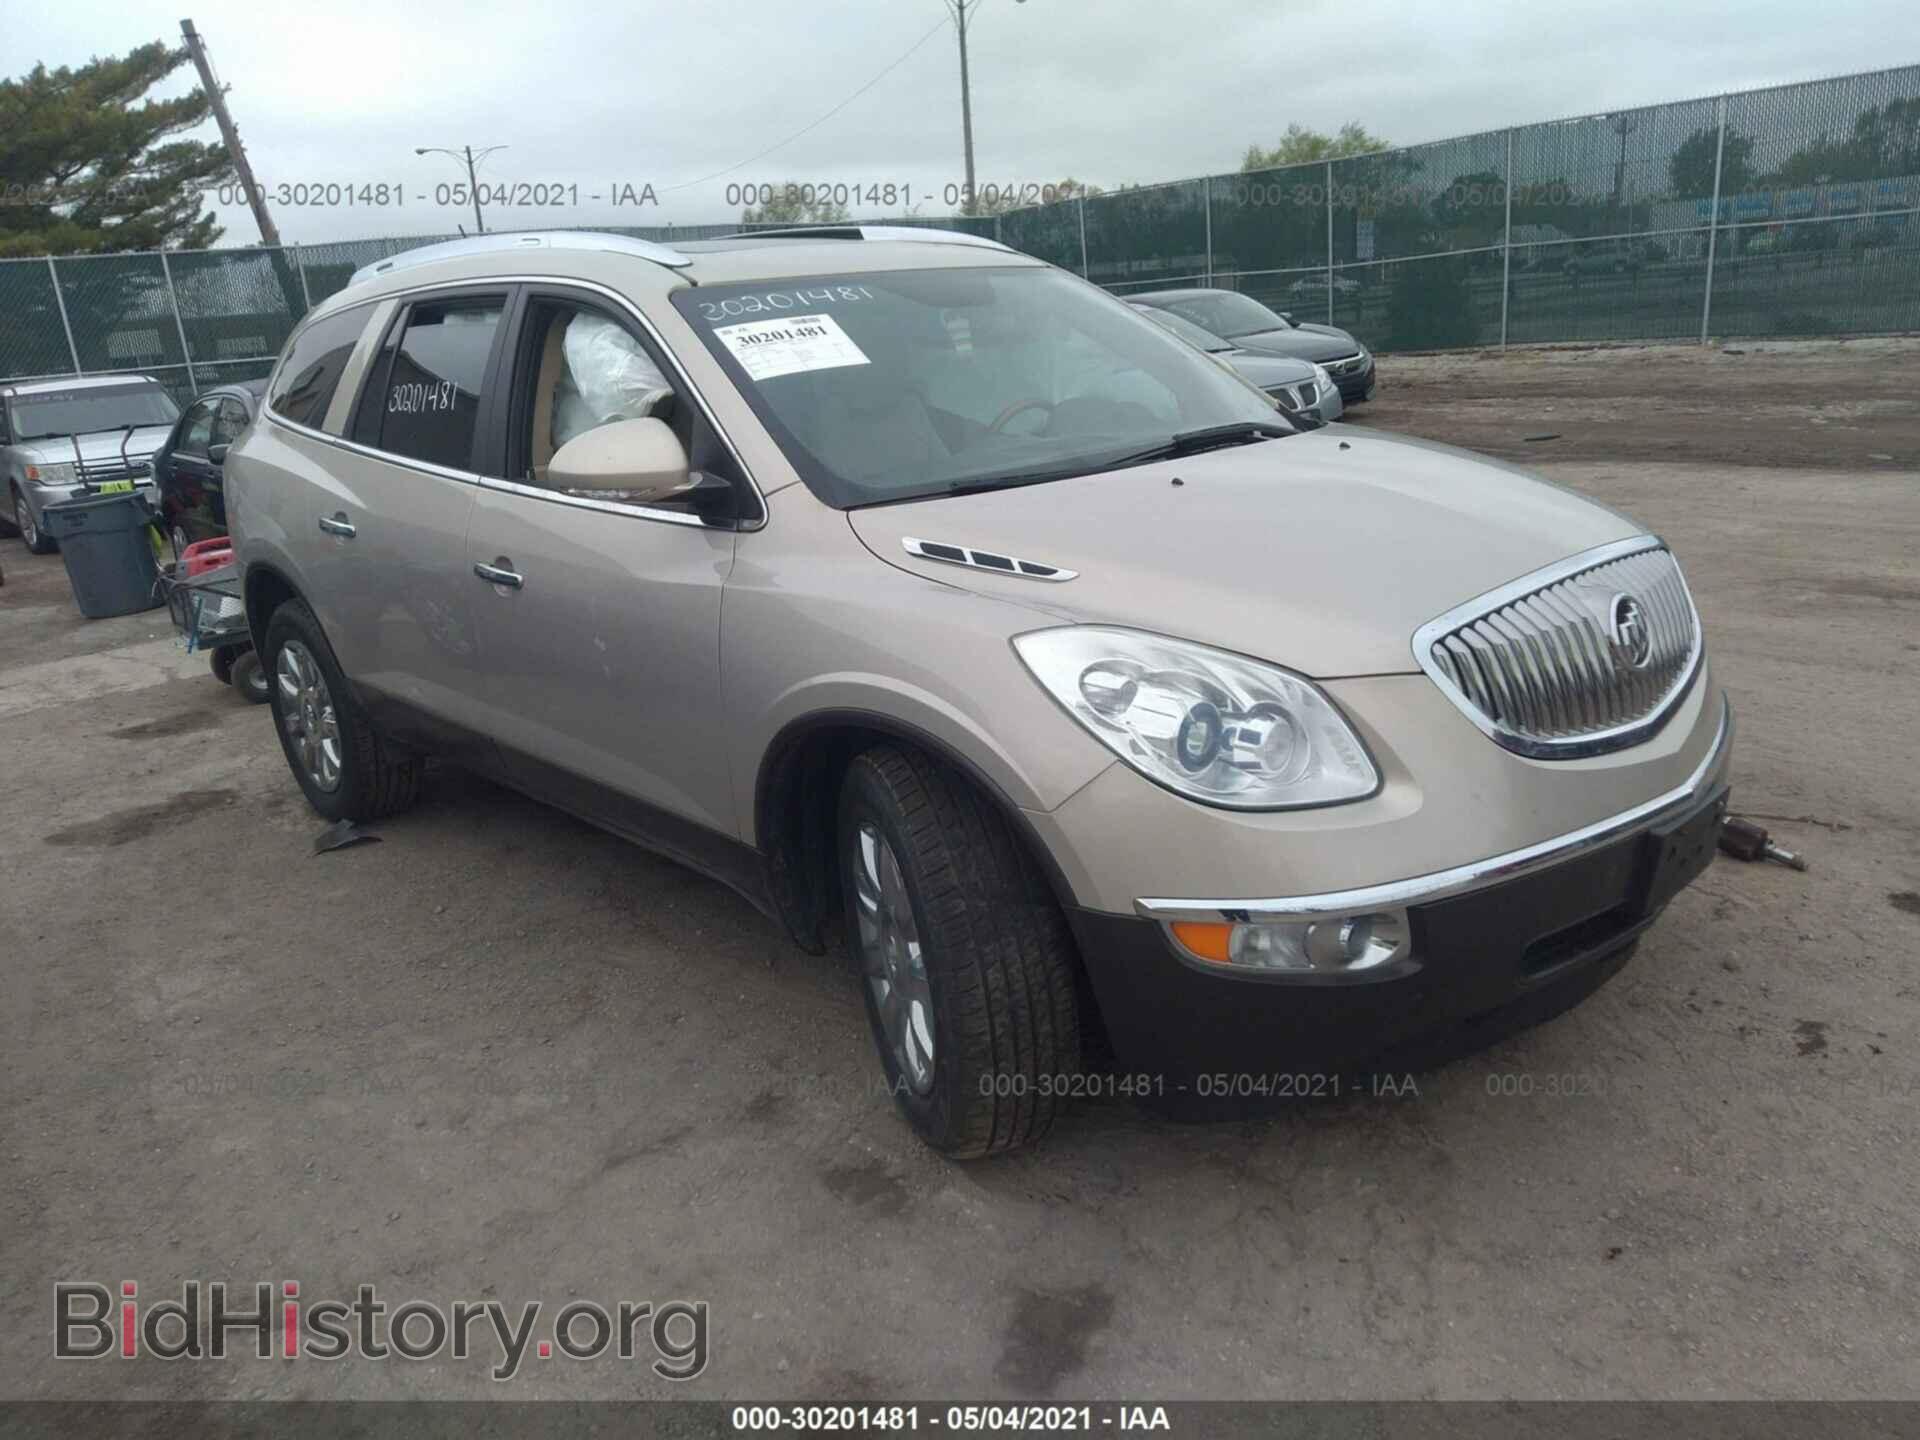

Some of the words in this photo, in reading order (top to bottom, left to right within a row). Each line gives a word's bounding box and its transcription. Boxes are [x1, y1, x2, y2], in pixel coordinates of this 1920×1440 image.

[698, 285, 874, 322] 30201481
[736, 326, 828, 348] 30201481
[388, 381, 458, 415] 30201481
